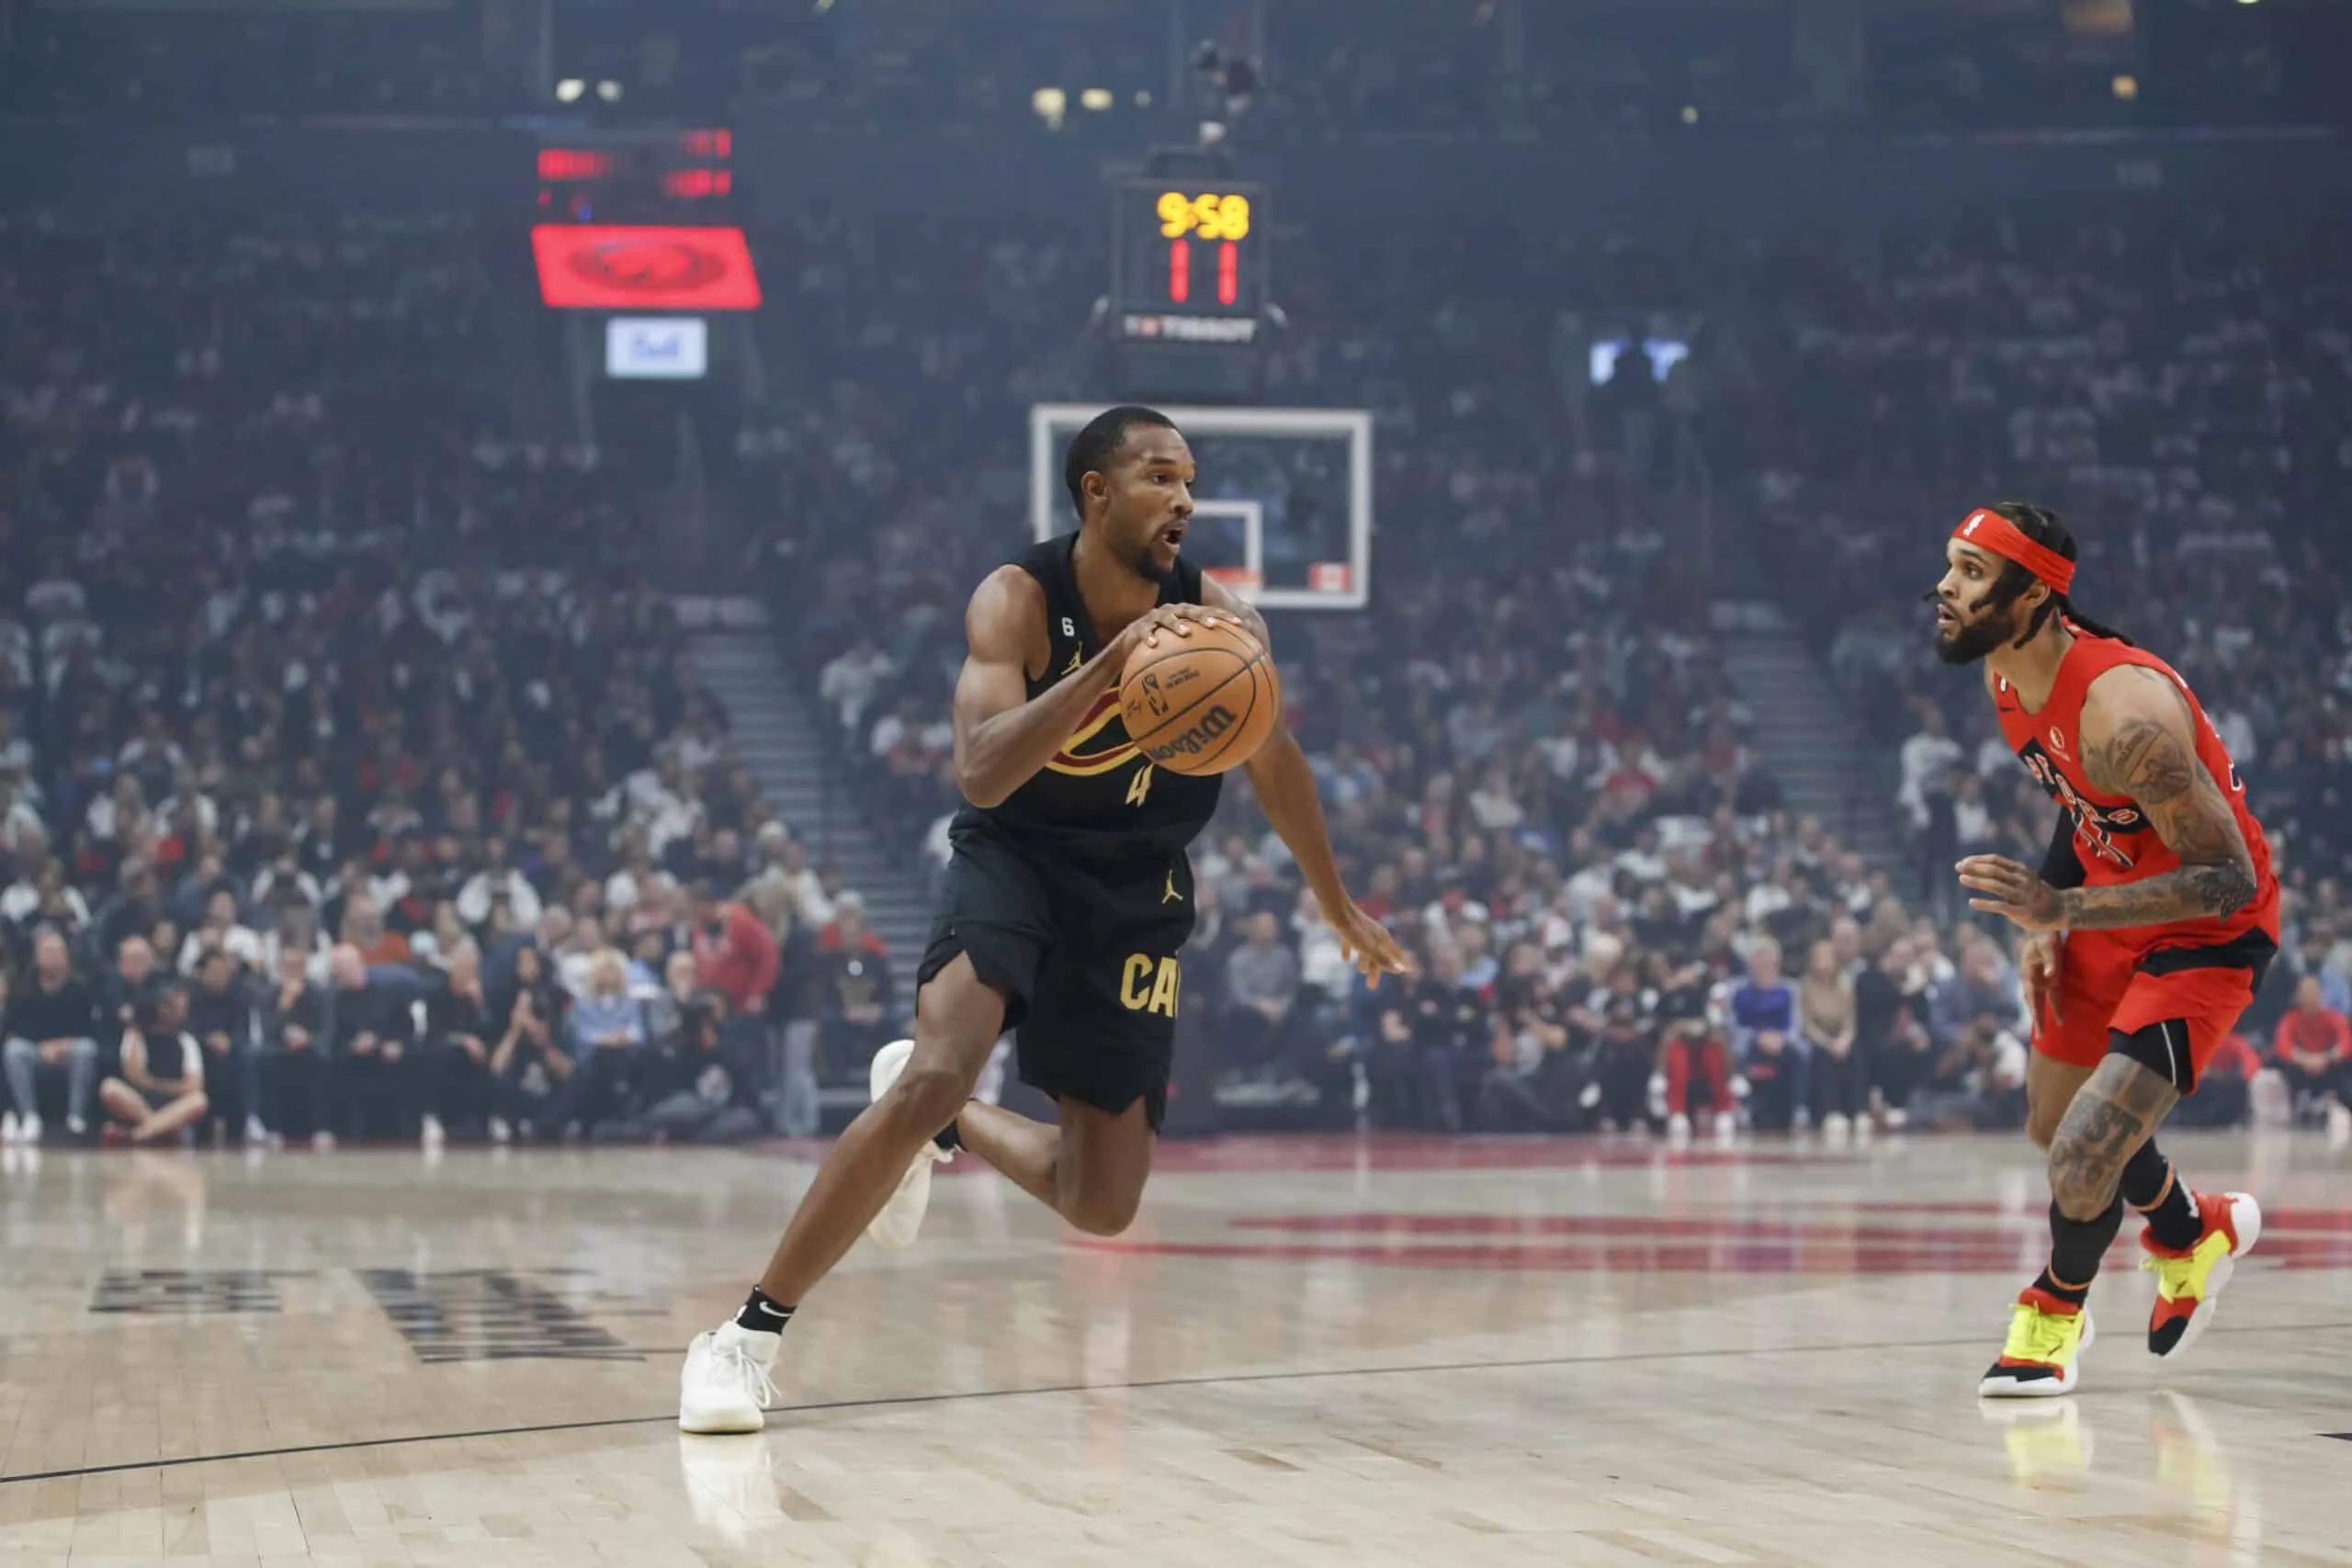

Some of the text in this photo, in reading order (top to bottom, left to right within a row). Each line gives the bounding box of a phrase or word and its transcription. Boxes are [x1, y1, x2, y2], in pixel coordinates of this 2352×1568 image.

[1157, 192, 1250, 241] 9:58
[1170, 238, 1238, 305] 11
[1061, 616, 1075, 637] 6
[1125, 762, 1155, 807] 4
[1120, 953, 1181, 1019] CA
